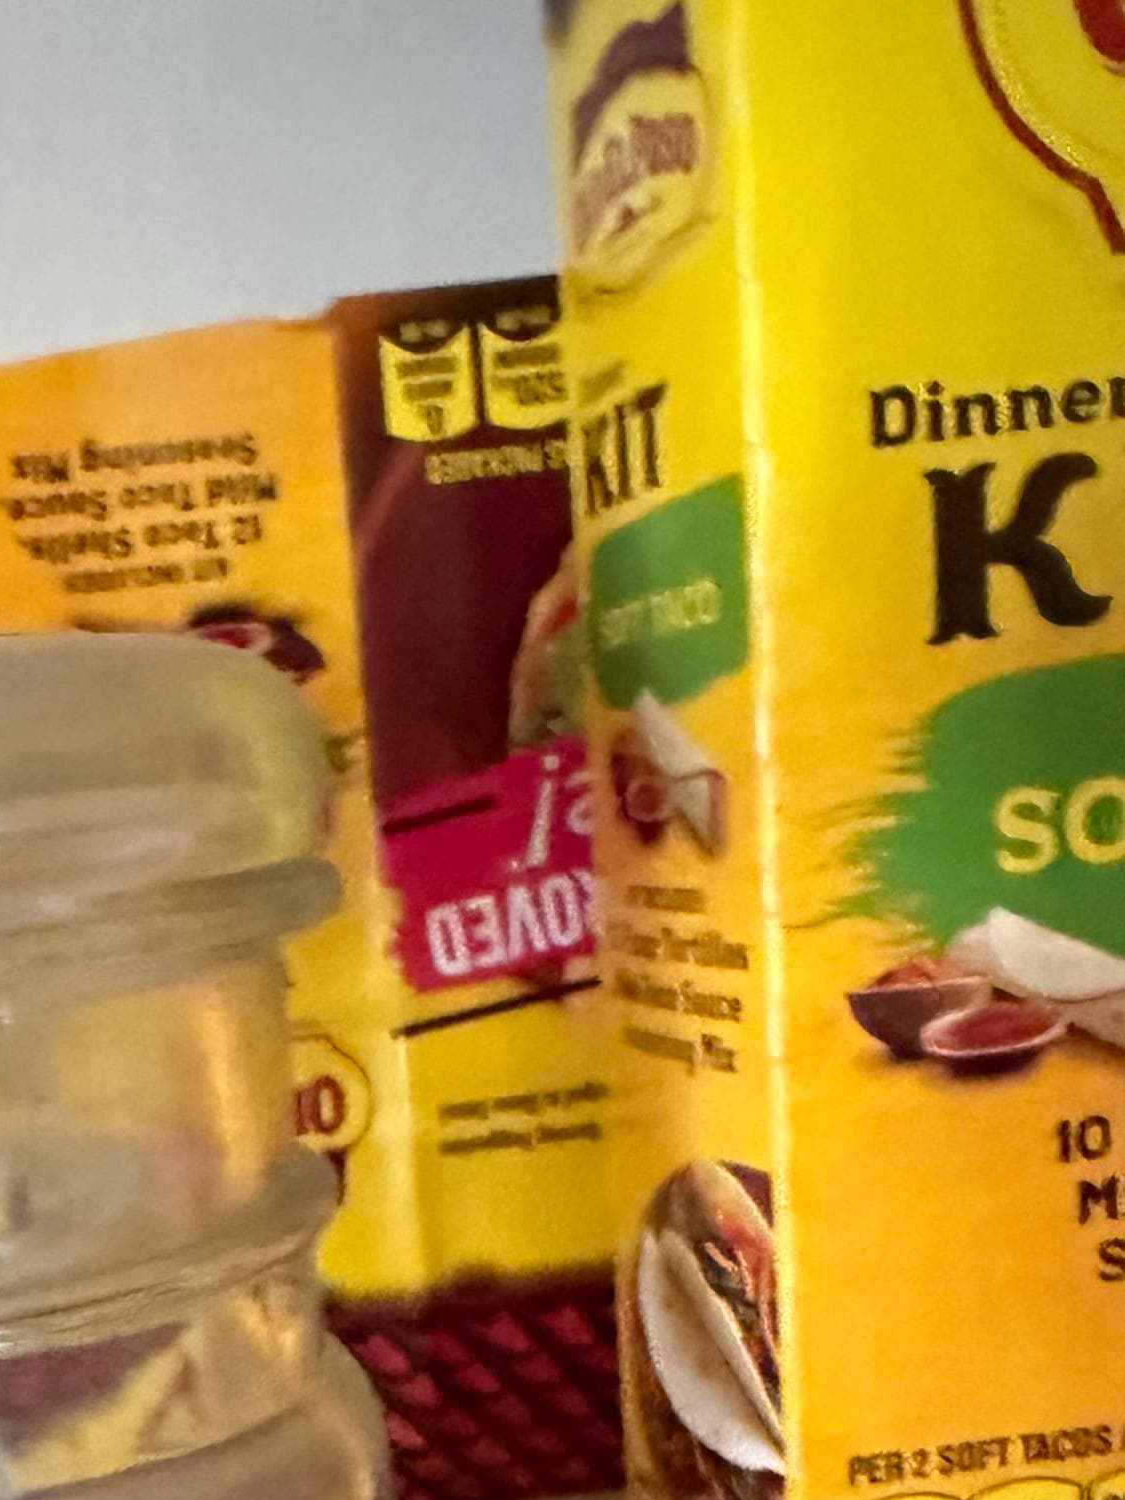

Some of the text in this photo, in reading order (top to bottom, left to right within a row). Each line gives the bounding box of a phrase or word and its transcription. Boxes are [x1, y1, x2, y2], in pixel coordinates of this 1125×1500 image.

[581, 380, 668, 516] KIT
[924, 451, 1114, 646] K
[996, 777, 1125, 875] SO
[849, 1424, 1114, 1487] PER 2 SOFT TACOS
